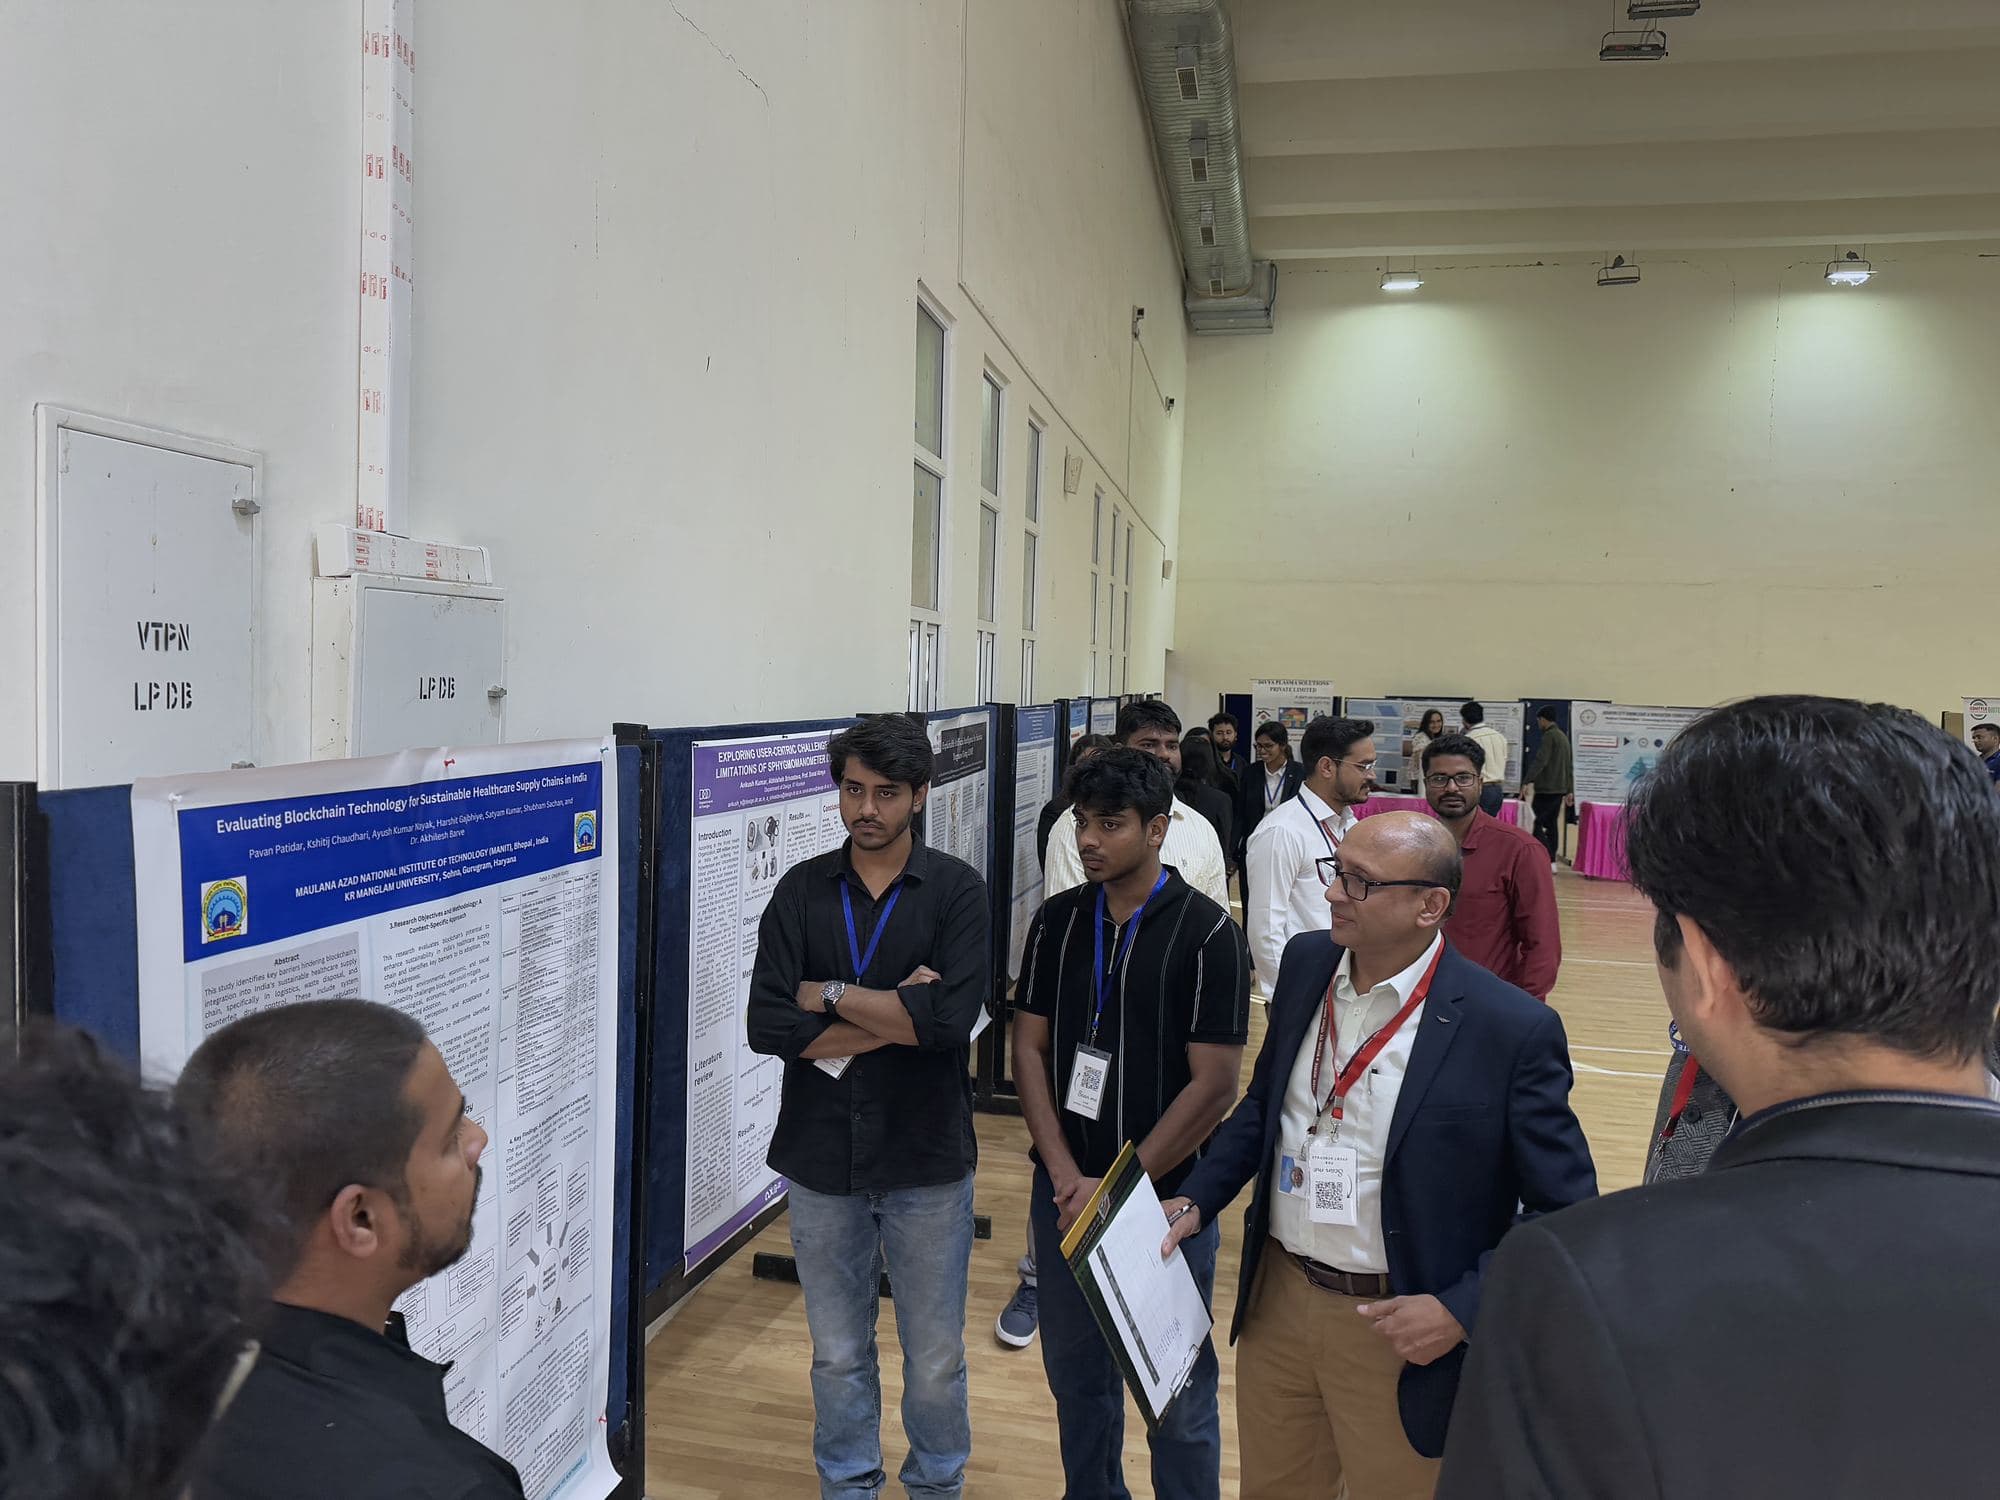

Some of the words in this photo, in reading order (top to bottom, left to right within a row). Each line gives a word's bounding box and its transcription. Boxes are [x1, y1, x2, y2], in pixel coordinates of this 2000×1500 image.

[138, 621, 189, 651] VTPN
[718, 748, 756, 763] EXPLORING
[756, 744, 796, 759] USER-CENTRIC
[716, 764, 757, 778] LIMITATIONS
[758, 763, 766, 773] OF
[768, 754, 826, 772] SPHYGMOMANOMETER
[217, 814, 282, 833] Evaluating
[284, 805, 346, 824] Blockchain
[348, 798, 408, 816] Technology
[409, 796, 420, 808] for
[420, 788, 472, 804] Sustainable
[473, 784, 514, 798] Healthcare
[516, 779, 540, 792] Supply
[542, 775, 564, 787] Chains
[565, 774, 572, 784] in
[572, 772, 587, 784] India
[249, 848, 273, 859] Pavan
[275, 842, 305, 854] Patidar,
[307, 838, 330, 849] Kshitij
[332, 830, 370, 845] Chaudhari,
[372, 826, 392, 840] Ayush
[393, 822, 414, 836] Kumar
[436, 815, 458, 828] Harshit
[565, 797, 573, 806] and
[410, 836, 419, 846] Dr.
[420, 831, 448, 844] Akhilesh
[449, 828, 465, 839] Barve
[698, 828, 732, 841] Introduction
[296, 880, 336, 898] MAULANA
[338, 875, 359, 888] AZAD
[360, 867, 398, 884] NATIONAL
[399, 860, 436, 876] INSTITUTE
[438, 858, 447, 868] OF
[448, 849, 489, 865] TECHNOLOGY
[536, 836, 548, 846] India
[344, 891, 355, 902] KR
[356, 882, 395, 899] MANGLAM
[396, 873, 442, 890] UNIVERSITY,
[462, 862, 493, 876] Gurugram,
[494, 855, 517, 868] Haryana
[409, 918, 448, 934] Context-Specific
[418, 912, 443, 922] Objectives
[444, 908, 452, 916] and
[274, 954, 300, 966] Abstract
[204, 988, 217, 997] This
[218, 982, 235, 993] study
[236, 974, 265, 989] identifies
[267, 971, 278, 982] key
[279, 964, 300, 976] barriers
[204, 992, 237, 1008] integration
[239, 988, 251, 997] into
[254, 982, 275, 993] India's
[278, 972, 309, 986] sustainable
[311, 964, 338, 976] healthcare
[340, 958, 358, 970] supply
[226, 994, 259, 1012] specifically
[264, 991, 270, 1000] in
[275, 985, 300, 998] logistics,
[348, 966, 358, 976] and
[295, 991, 311, 1001] These
[317, 983, 336, 995] include
[695, 1050, 722, 1072] Literature
[694, 1070, 714, 1087] review
